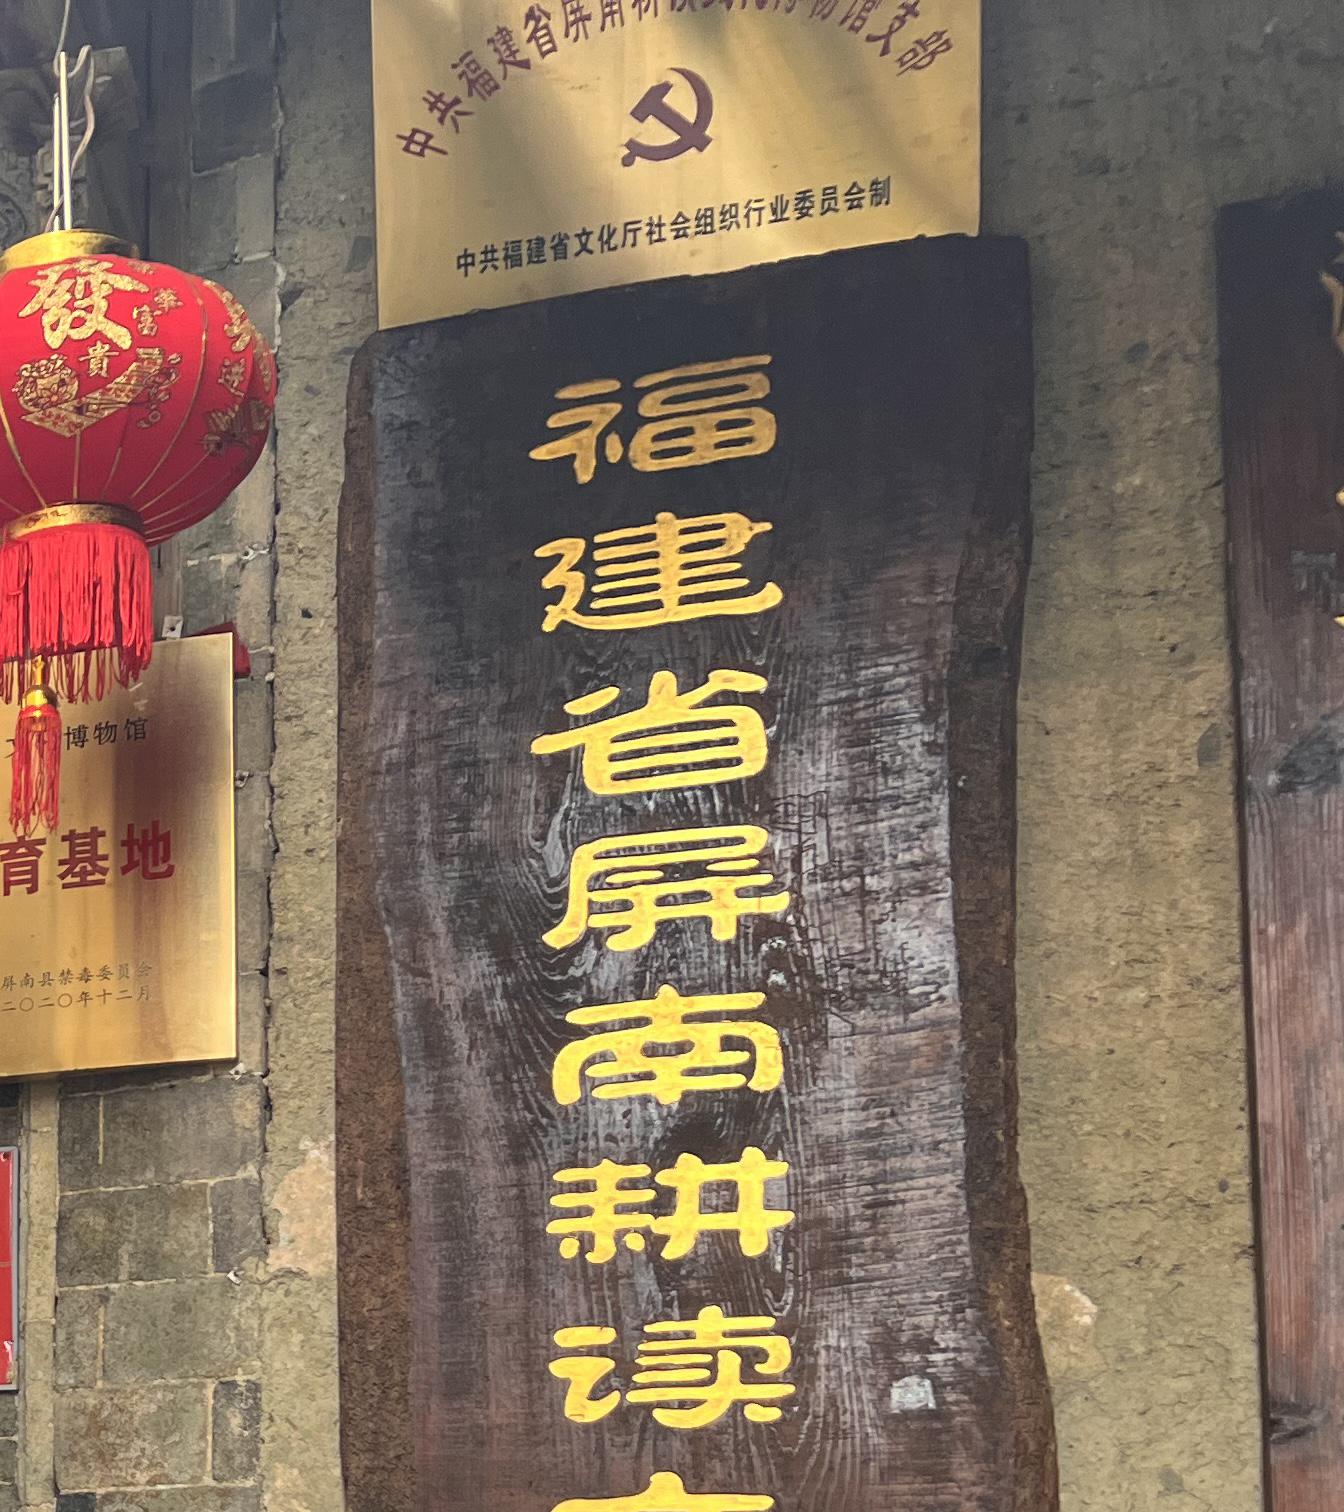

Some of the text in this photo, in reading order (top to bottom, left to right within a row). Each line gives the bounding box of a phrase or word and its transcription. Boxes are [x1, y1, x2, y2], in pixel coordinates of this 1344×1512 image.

[456, 175, 891, 278] 中共福建省文化厅社会组织行业委员会制
[0, 961, 153, 991] 屏南县禁毒委员会
